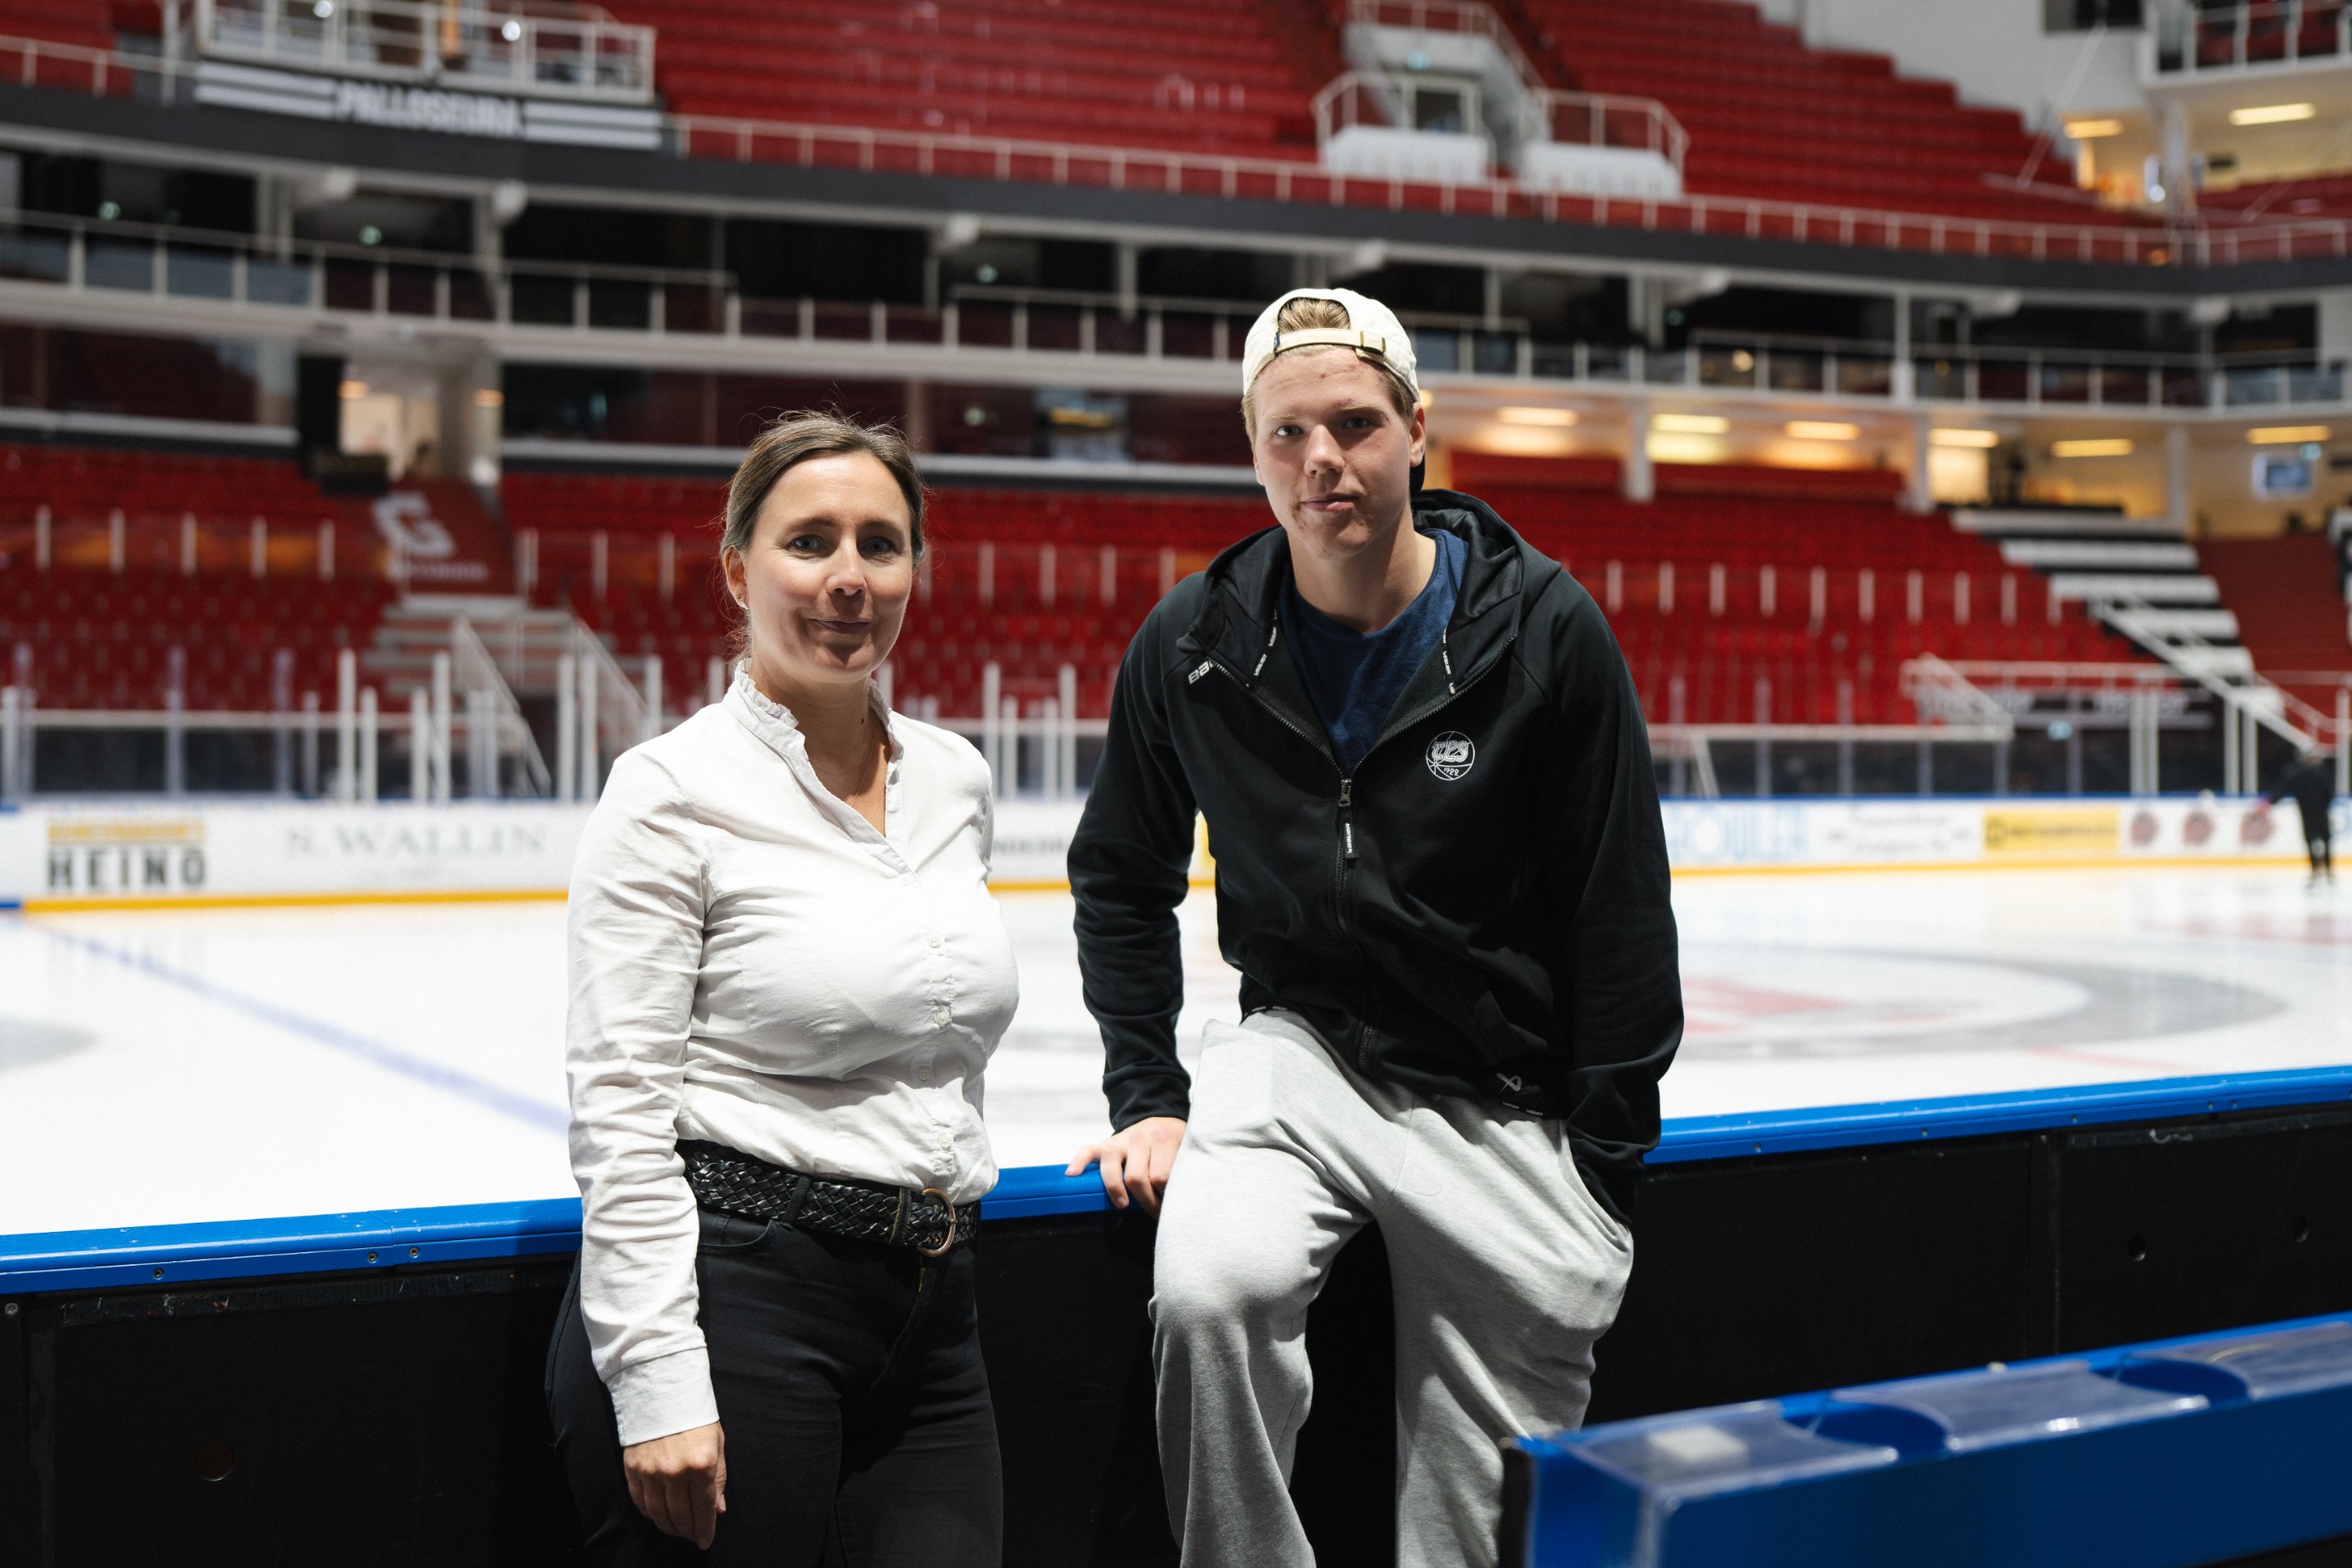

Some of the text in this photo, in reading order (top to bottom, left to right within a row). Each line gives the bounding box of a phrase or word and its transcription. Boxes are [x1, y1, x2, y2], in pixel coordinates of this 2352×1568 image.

[1443, 767, 1460, 776] 1922
[333, 826, 549, 861] WALLIN
[49, 850, 205, 888] HEINO
